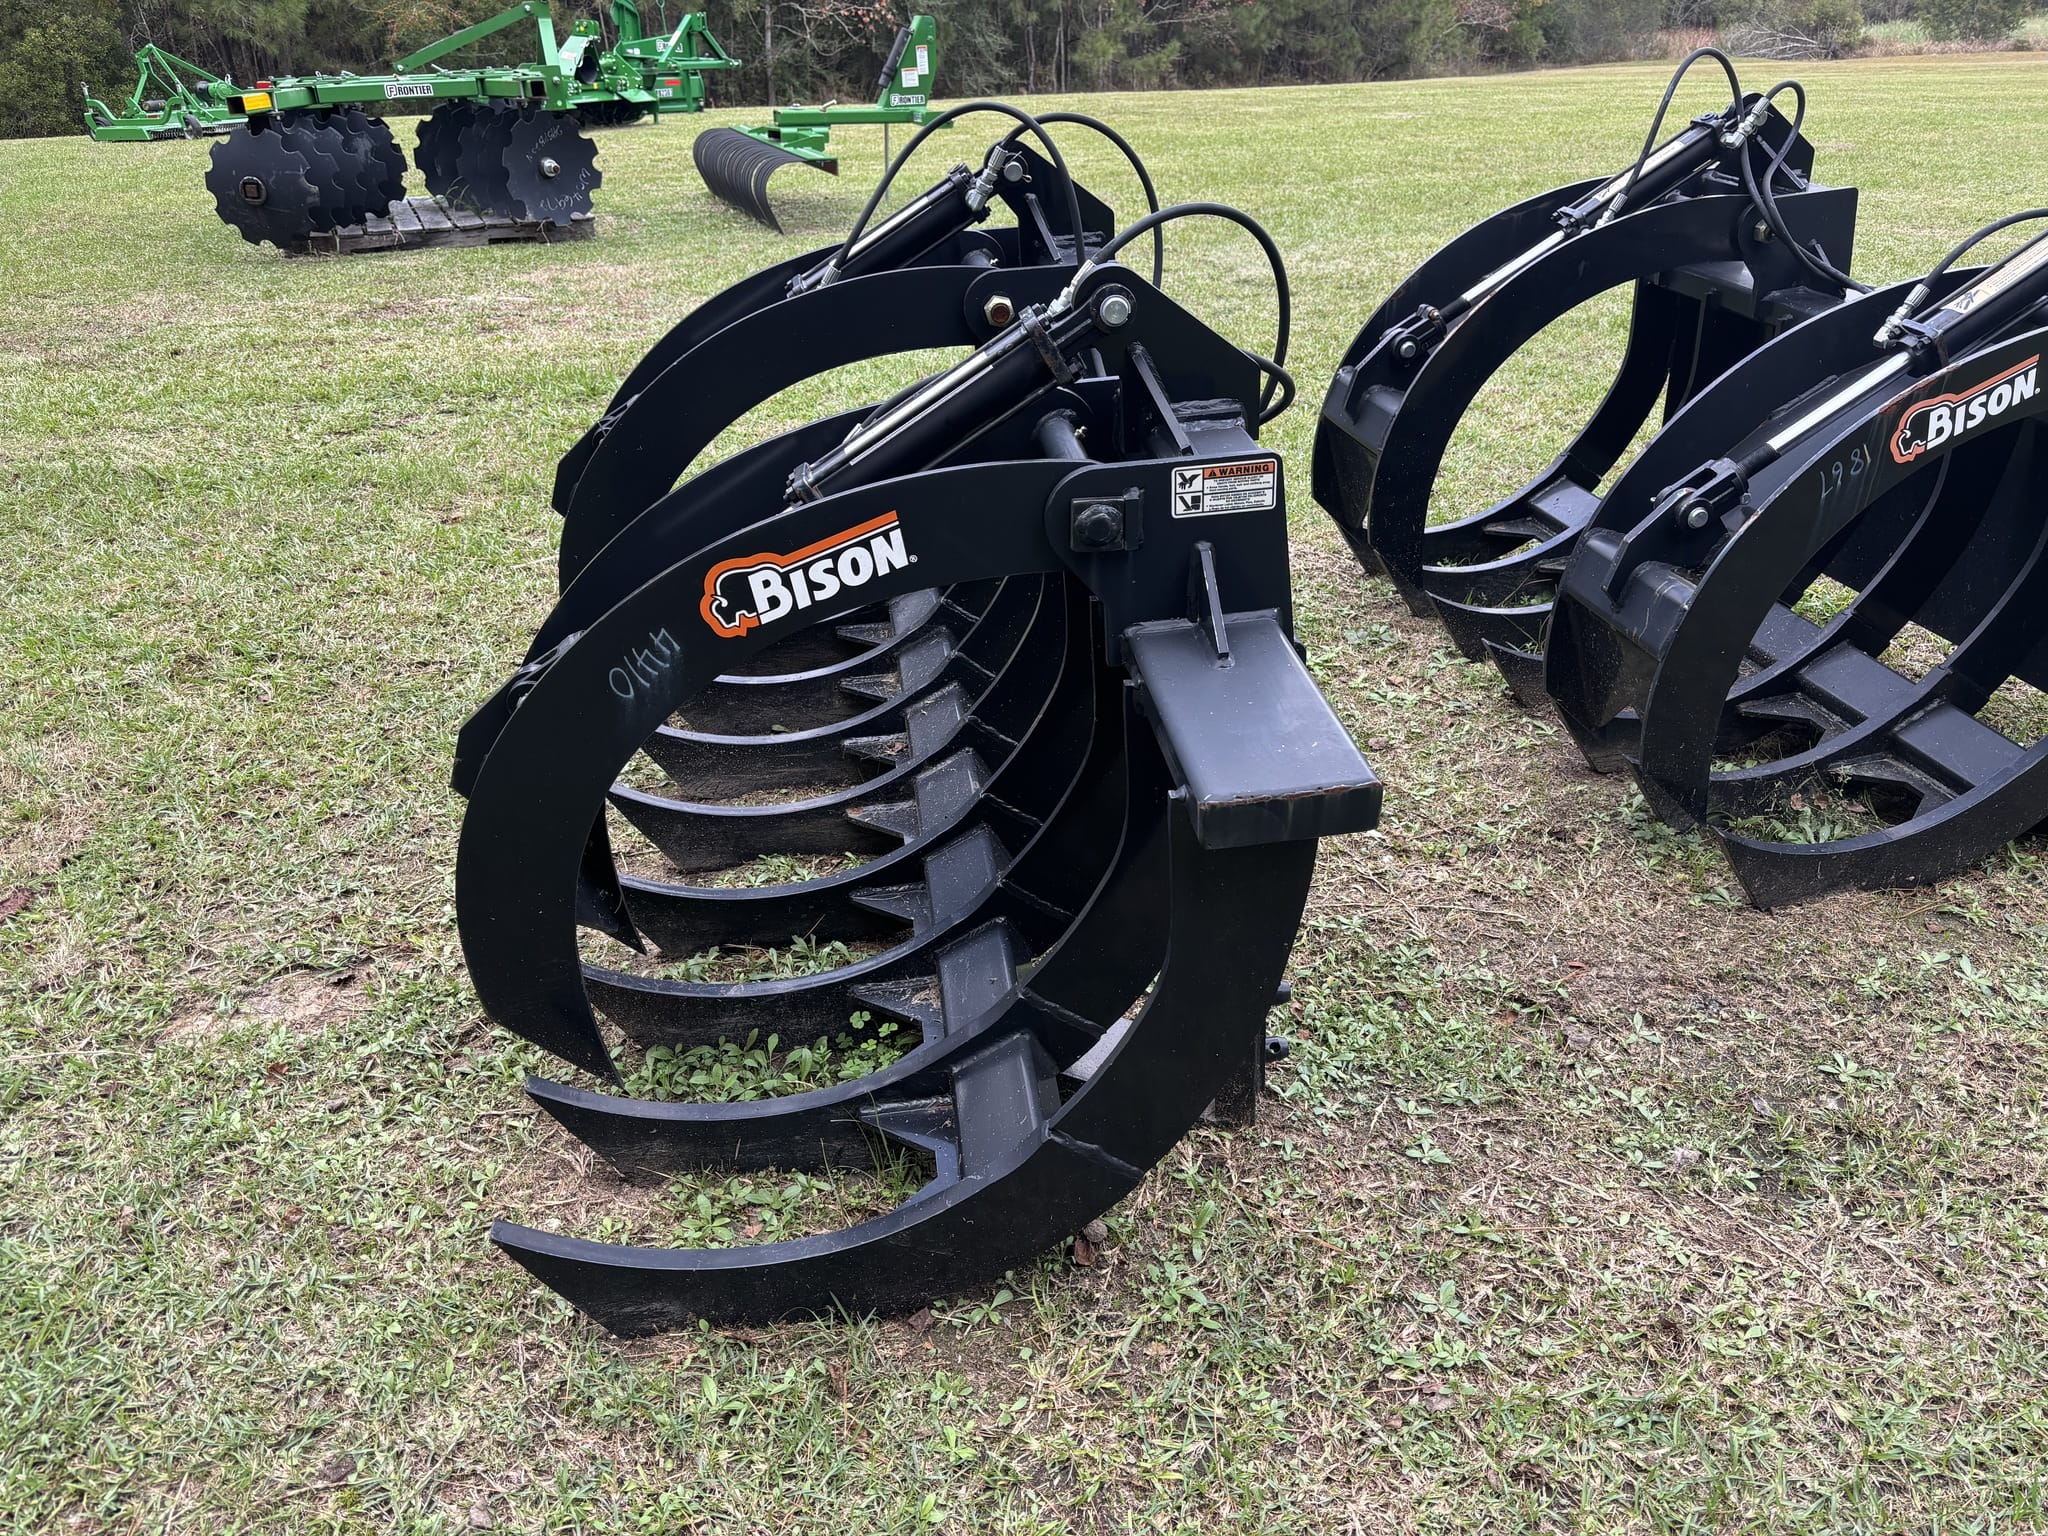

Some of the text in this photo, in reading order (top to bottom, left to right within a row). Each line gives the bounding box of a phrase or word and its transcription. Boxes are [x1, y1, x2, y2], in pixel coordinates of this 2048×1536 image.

[385, 84, 433, 98] FRONTIER
[891, 94, 924, 105] FRONTIER
[1926, 367, 2038, 451] BISON
[1219, 464, 1270, 477] WARNING
[748, 527, 909, 625] BISON
[608, 627, 681, 698] 4410
